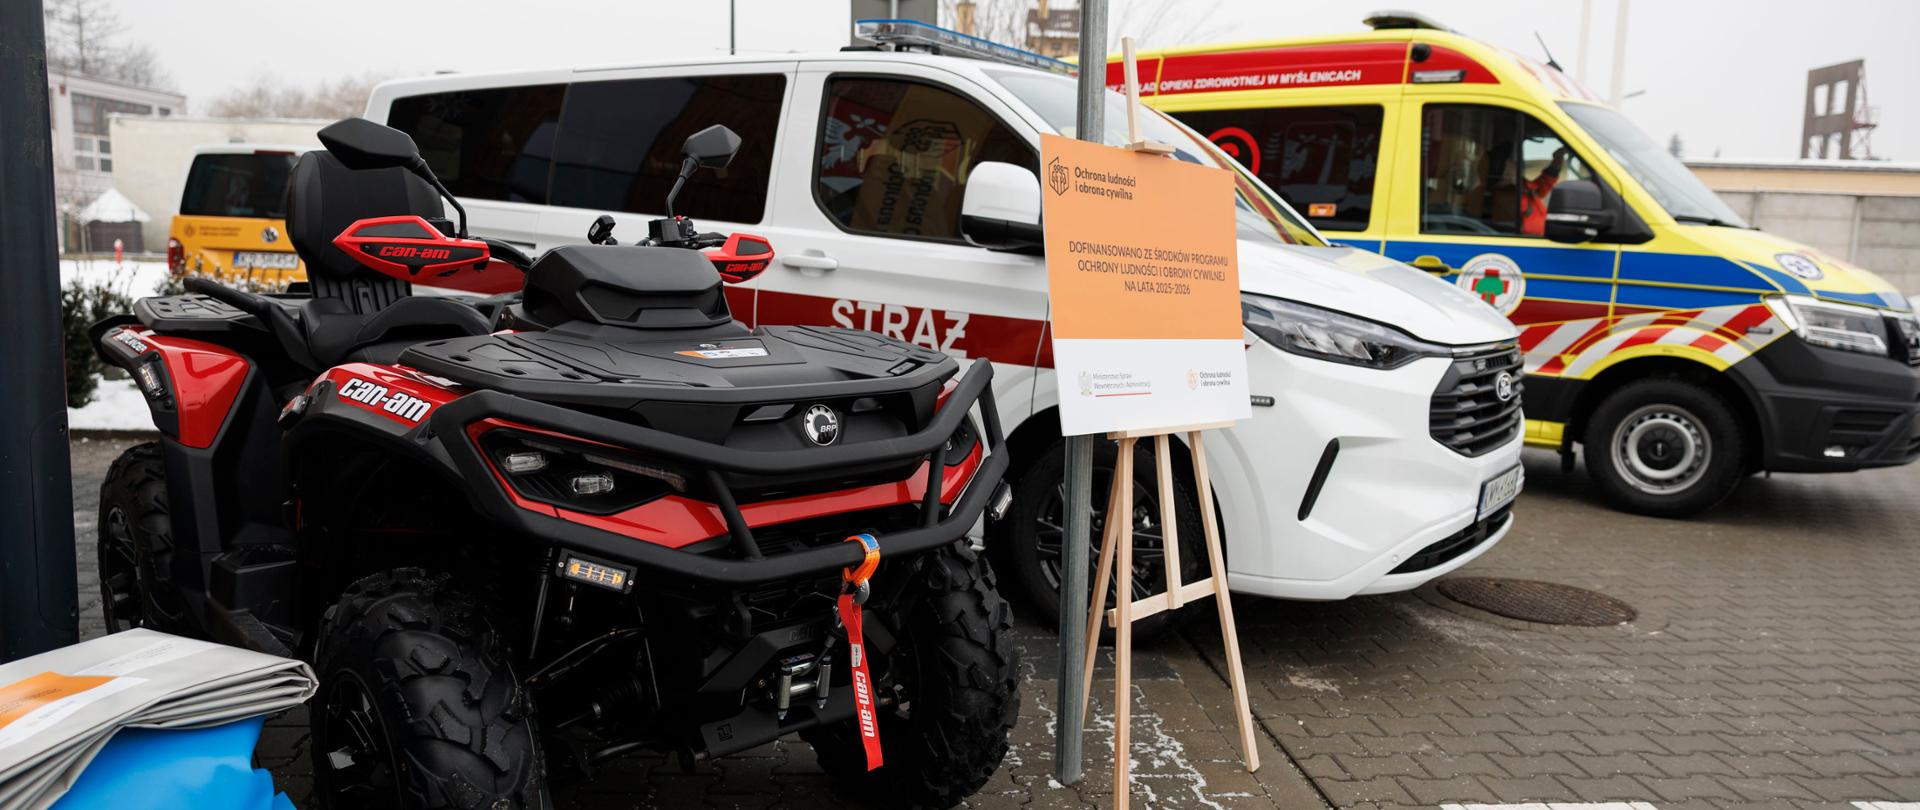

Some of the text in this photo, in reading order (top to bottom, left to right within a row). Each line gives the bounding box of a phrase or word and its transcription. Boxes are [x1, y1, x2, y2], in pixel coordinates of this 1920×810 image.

[1160, 80, 1193, 91] OPIEKI
[1194, 75, 1265, 89] ZDROWOTNEJ
[1267, 74, 1279, 85] W
[1280, 69, 1361, 84] MYŚLENICACH
[1074, 166, 1136, 187] Ochrona ludności
[1074, 181, 1133, 200] i obrona cywilna
[379, 246, 451, 259] can-am
[1069, 240, 1229, 267] DOFINANSOWANO ZE ŚRODKÓW PROGRAMU
[1078, 259, 1119, 274] OCHRONY
[1120, 262, 1159, 277] LUDNOŚCI
[1163, 266, 1193, 279] OBRONY
[1193, 268, 1225, 281] CYWILNEJ
[1124, 280, 1190, 295] NA LATA 2025-2026
[338, 377, 432, 422] can-am
[820, 424, 837, 433] BRP
[855, 670, 875, 737] can-am
